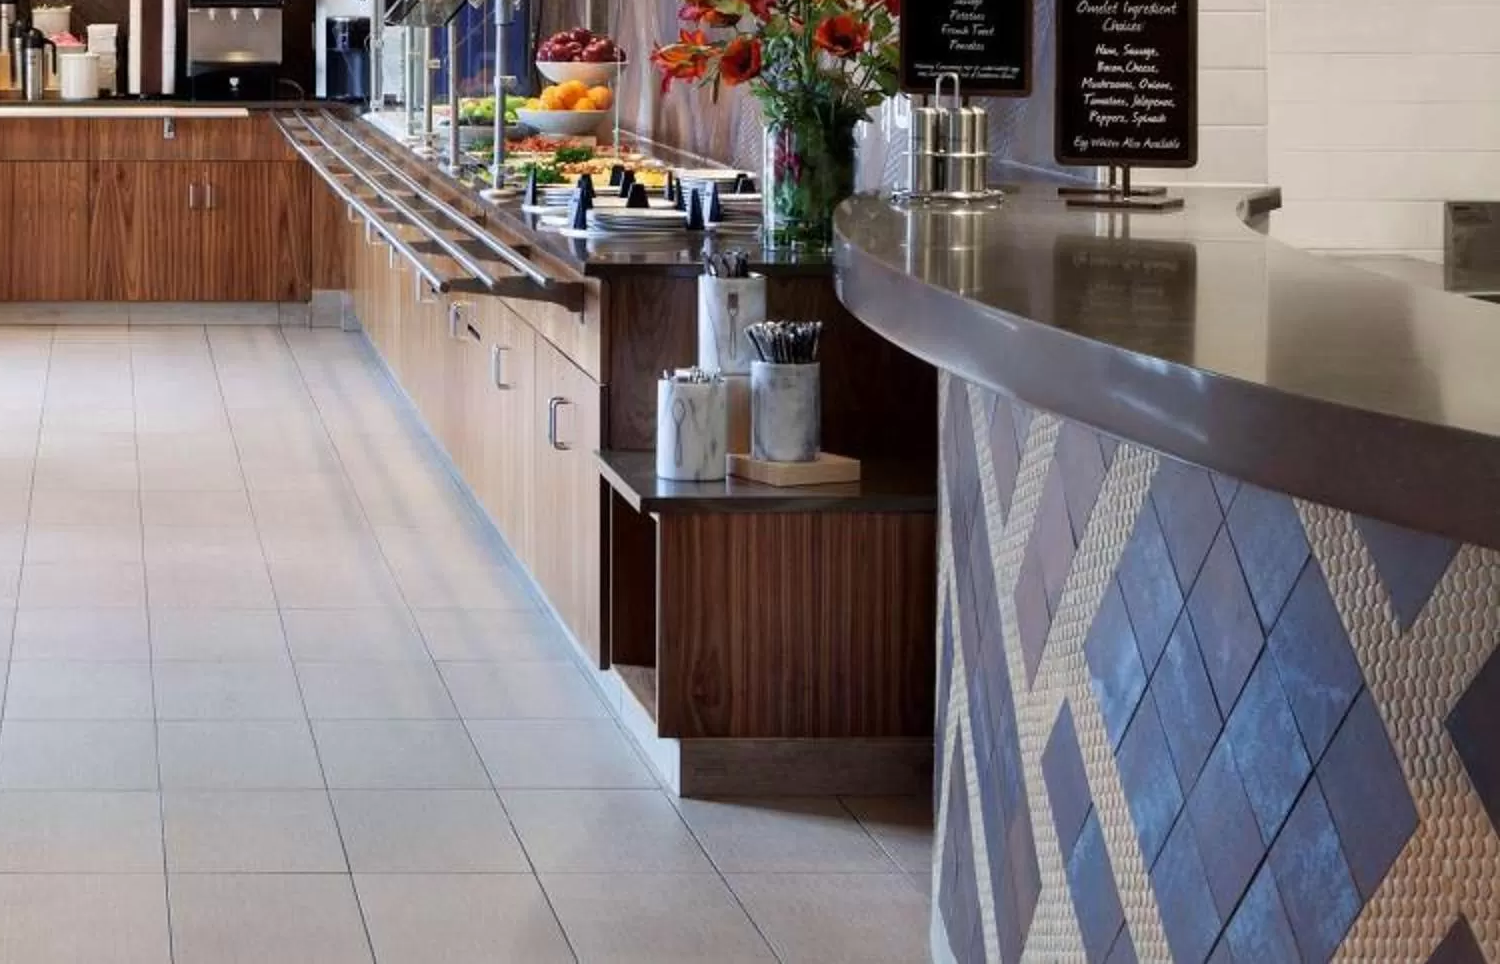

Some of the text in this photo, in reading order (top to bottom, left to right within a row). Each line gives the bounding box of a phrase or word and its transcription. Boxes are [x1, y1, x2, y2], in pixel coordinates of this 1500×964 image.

[1076, 0, 1178, 20] Omelet Ingredient
[1131, 111, 1167, 128] Spinach
[1073, 135, 1088, 152] Egg
